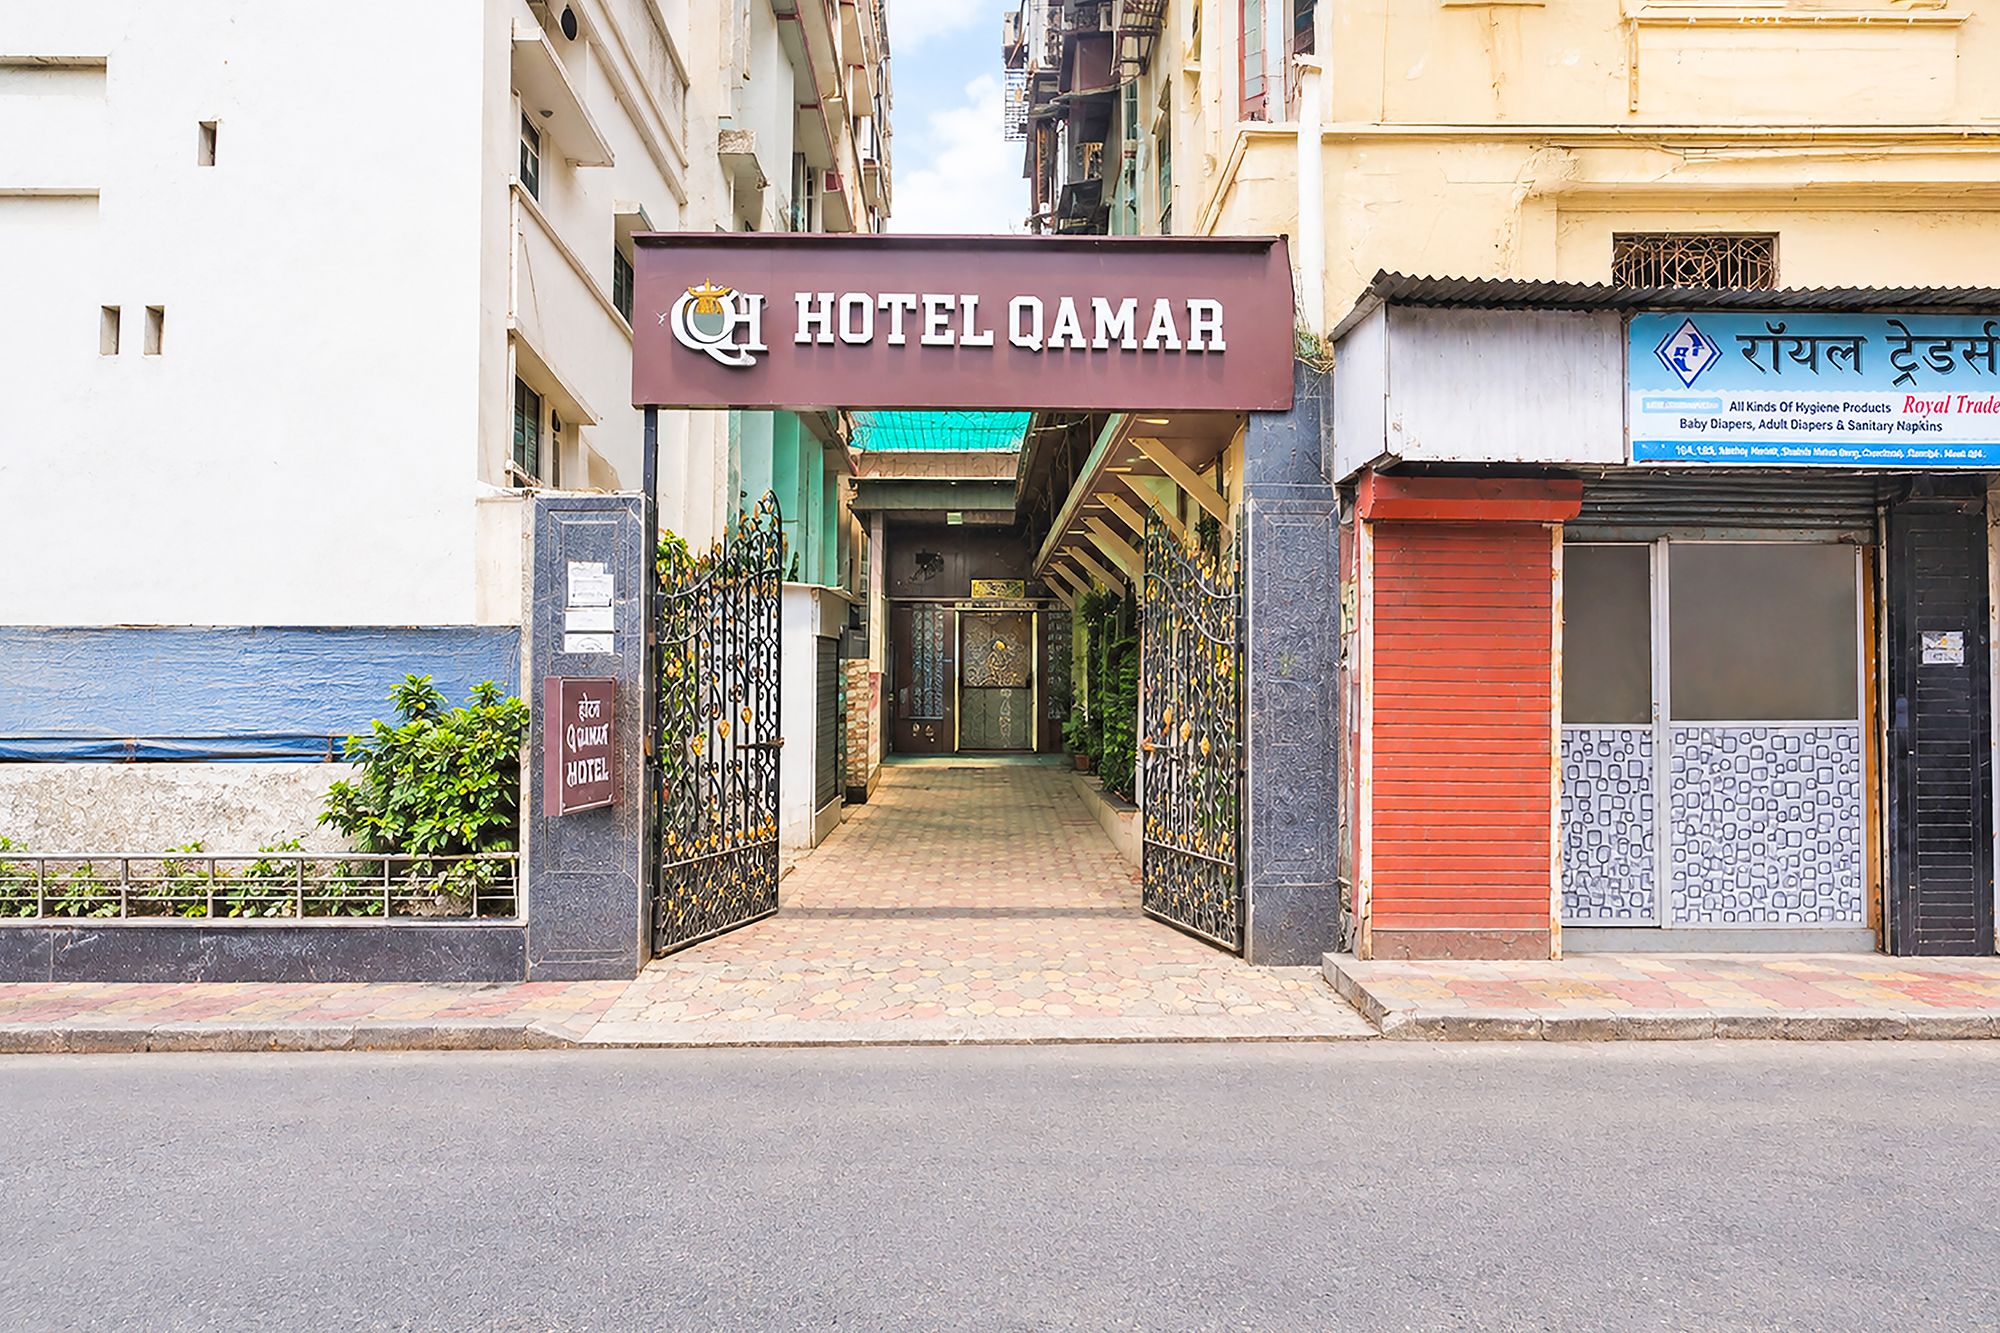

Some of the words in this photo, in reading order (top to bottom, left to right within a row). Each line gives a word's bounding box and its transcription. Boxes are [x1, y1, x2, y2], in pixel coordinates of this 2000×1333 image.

[794, 292, 994, 346] HOTEL
[1008, 296, 1226, 351] QAMAR
[1736, 321, 1868, 376] रॉयल
[1729, 401, 1744, 412] All
[1746, 401, 1777, 412] Kinds
[1779, 401, 1793, 412] Of
[1796, 402, 1839, 415] Hygiene
[1843, 402, 1892, 413] Products
[1903, 395, 1949, 418] Royal
[1680, 418, 1707, 431] Baby
[1711, 419, 1755, 431] Diapers,
[1759, 418, 1788, 430] Adult
[1791, 419, 1833, 432] Diapers
[1836, 420, 1844, 430] &
[1847, 420, 1894, 434] Sanitary
[1897, 421, 1943, 434] Napkins
[566, 757, 609, 787] HOTEL
